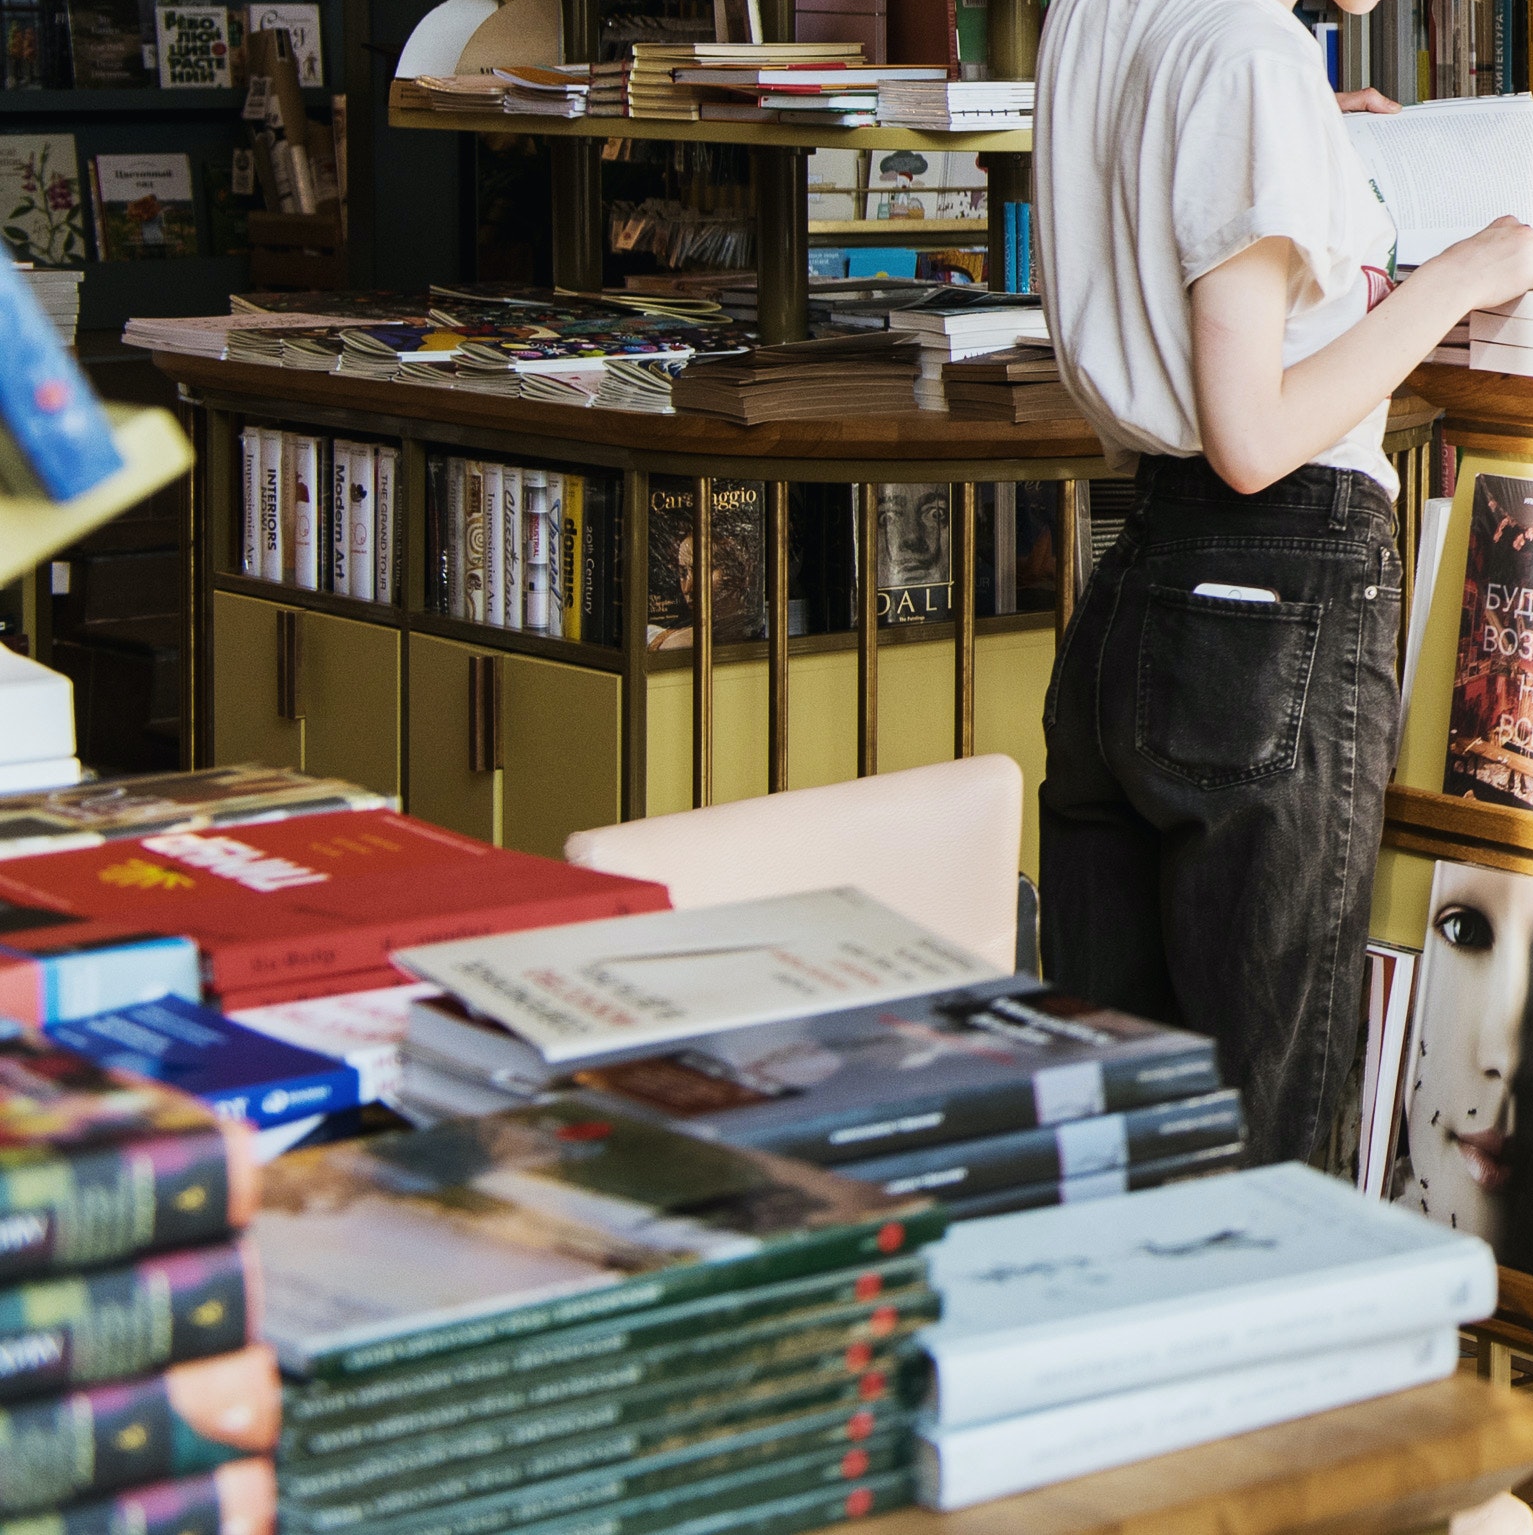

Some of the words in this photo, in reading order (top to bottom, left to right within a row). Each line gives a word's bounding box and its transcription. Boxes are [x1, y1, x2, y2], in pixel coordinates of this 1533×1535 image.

[267, 468, 277, 552] INTERIORS
[336, 465, 345, 543] Modern
[335, 548, 344, 580] Art
[563, 518, 574, 609] domus
